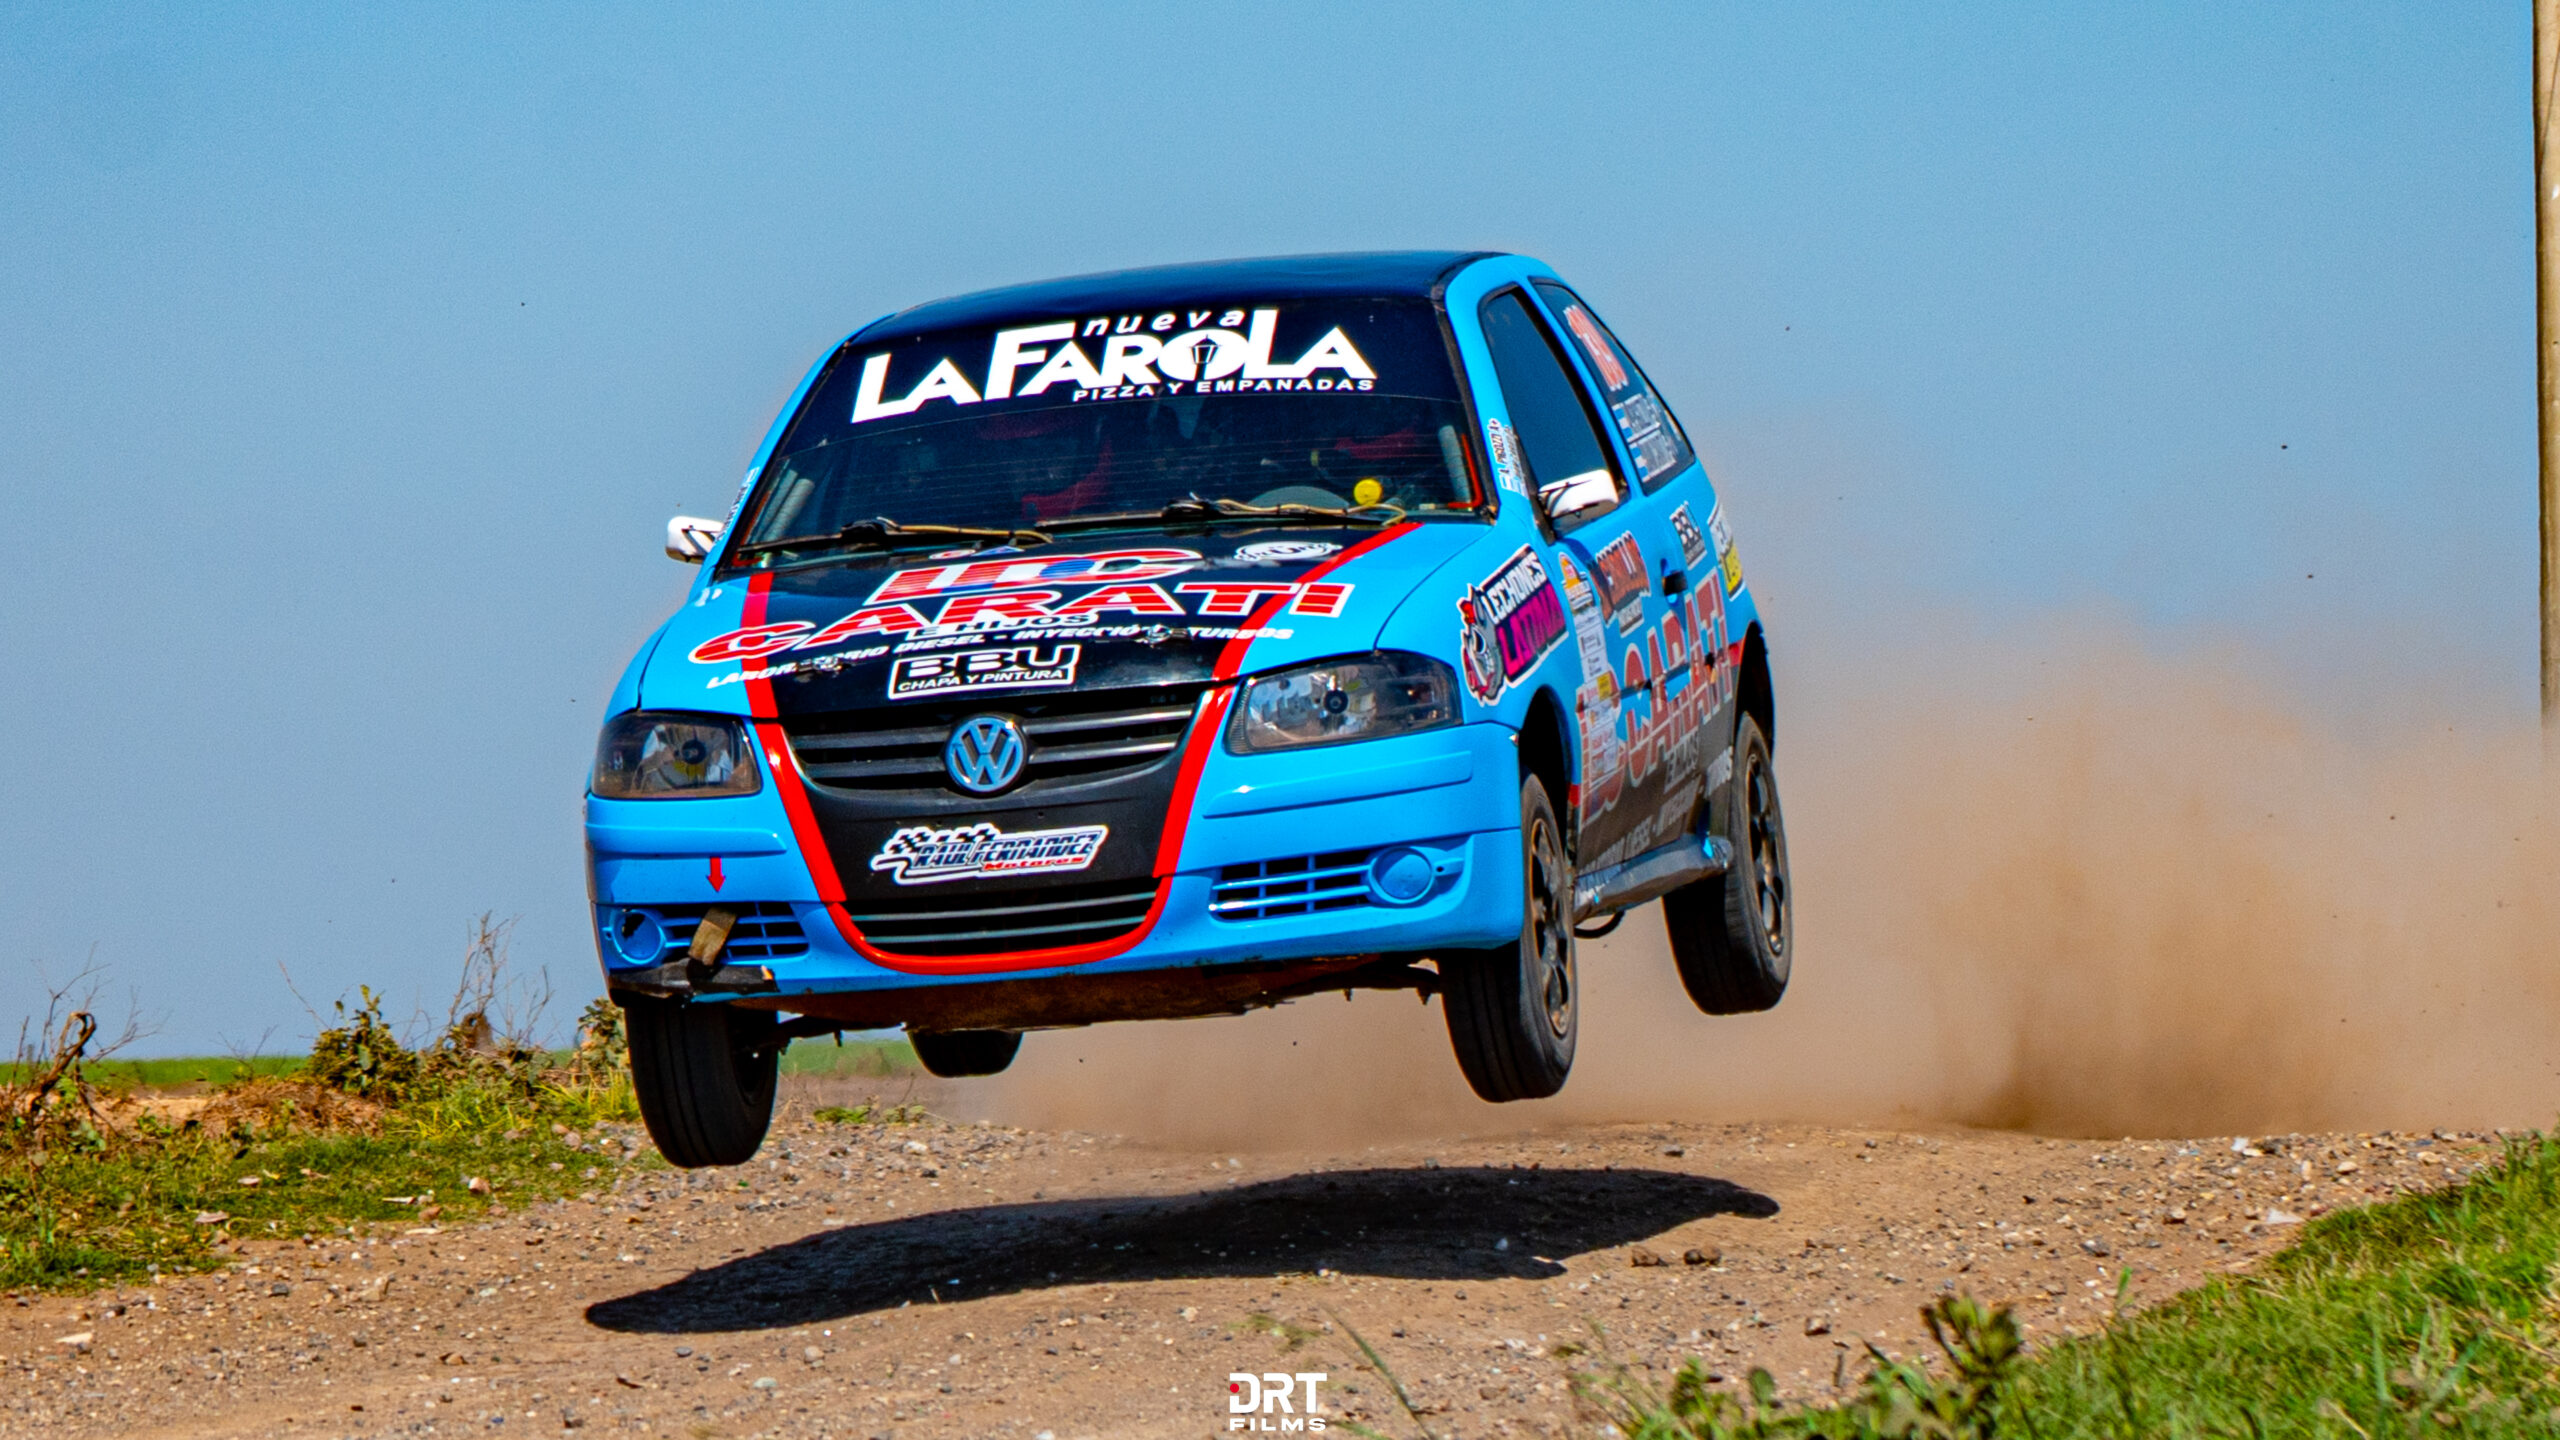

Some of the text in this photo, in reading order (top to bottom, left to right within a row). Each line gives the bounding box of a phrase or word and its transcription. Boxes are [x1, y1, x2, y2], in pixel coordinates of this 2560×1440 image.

[1082, 309, 1245, 336] nueva
[851, 308, 1378, 424] LA FAROLA
[1073, 378, 1376, 402] PIZZA Y EMPANADAS
[1481, 551, 1549, 625] LECHONES
[688, 582, 1356, 664] CARATI
[705, 645, 890, 690] LABORRIO
[893, 634, 985, 654] DIESEL
[1012, 622, 1160, 641] INYECCIÓ
[1187, 625, 1295, 641] TURBOS
[897, 644, 1080, 679] BBU
[898, 669, 1064, 692] CHAPA Y PINTURA
[983, 857, 1086, 871] Motores
